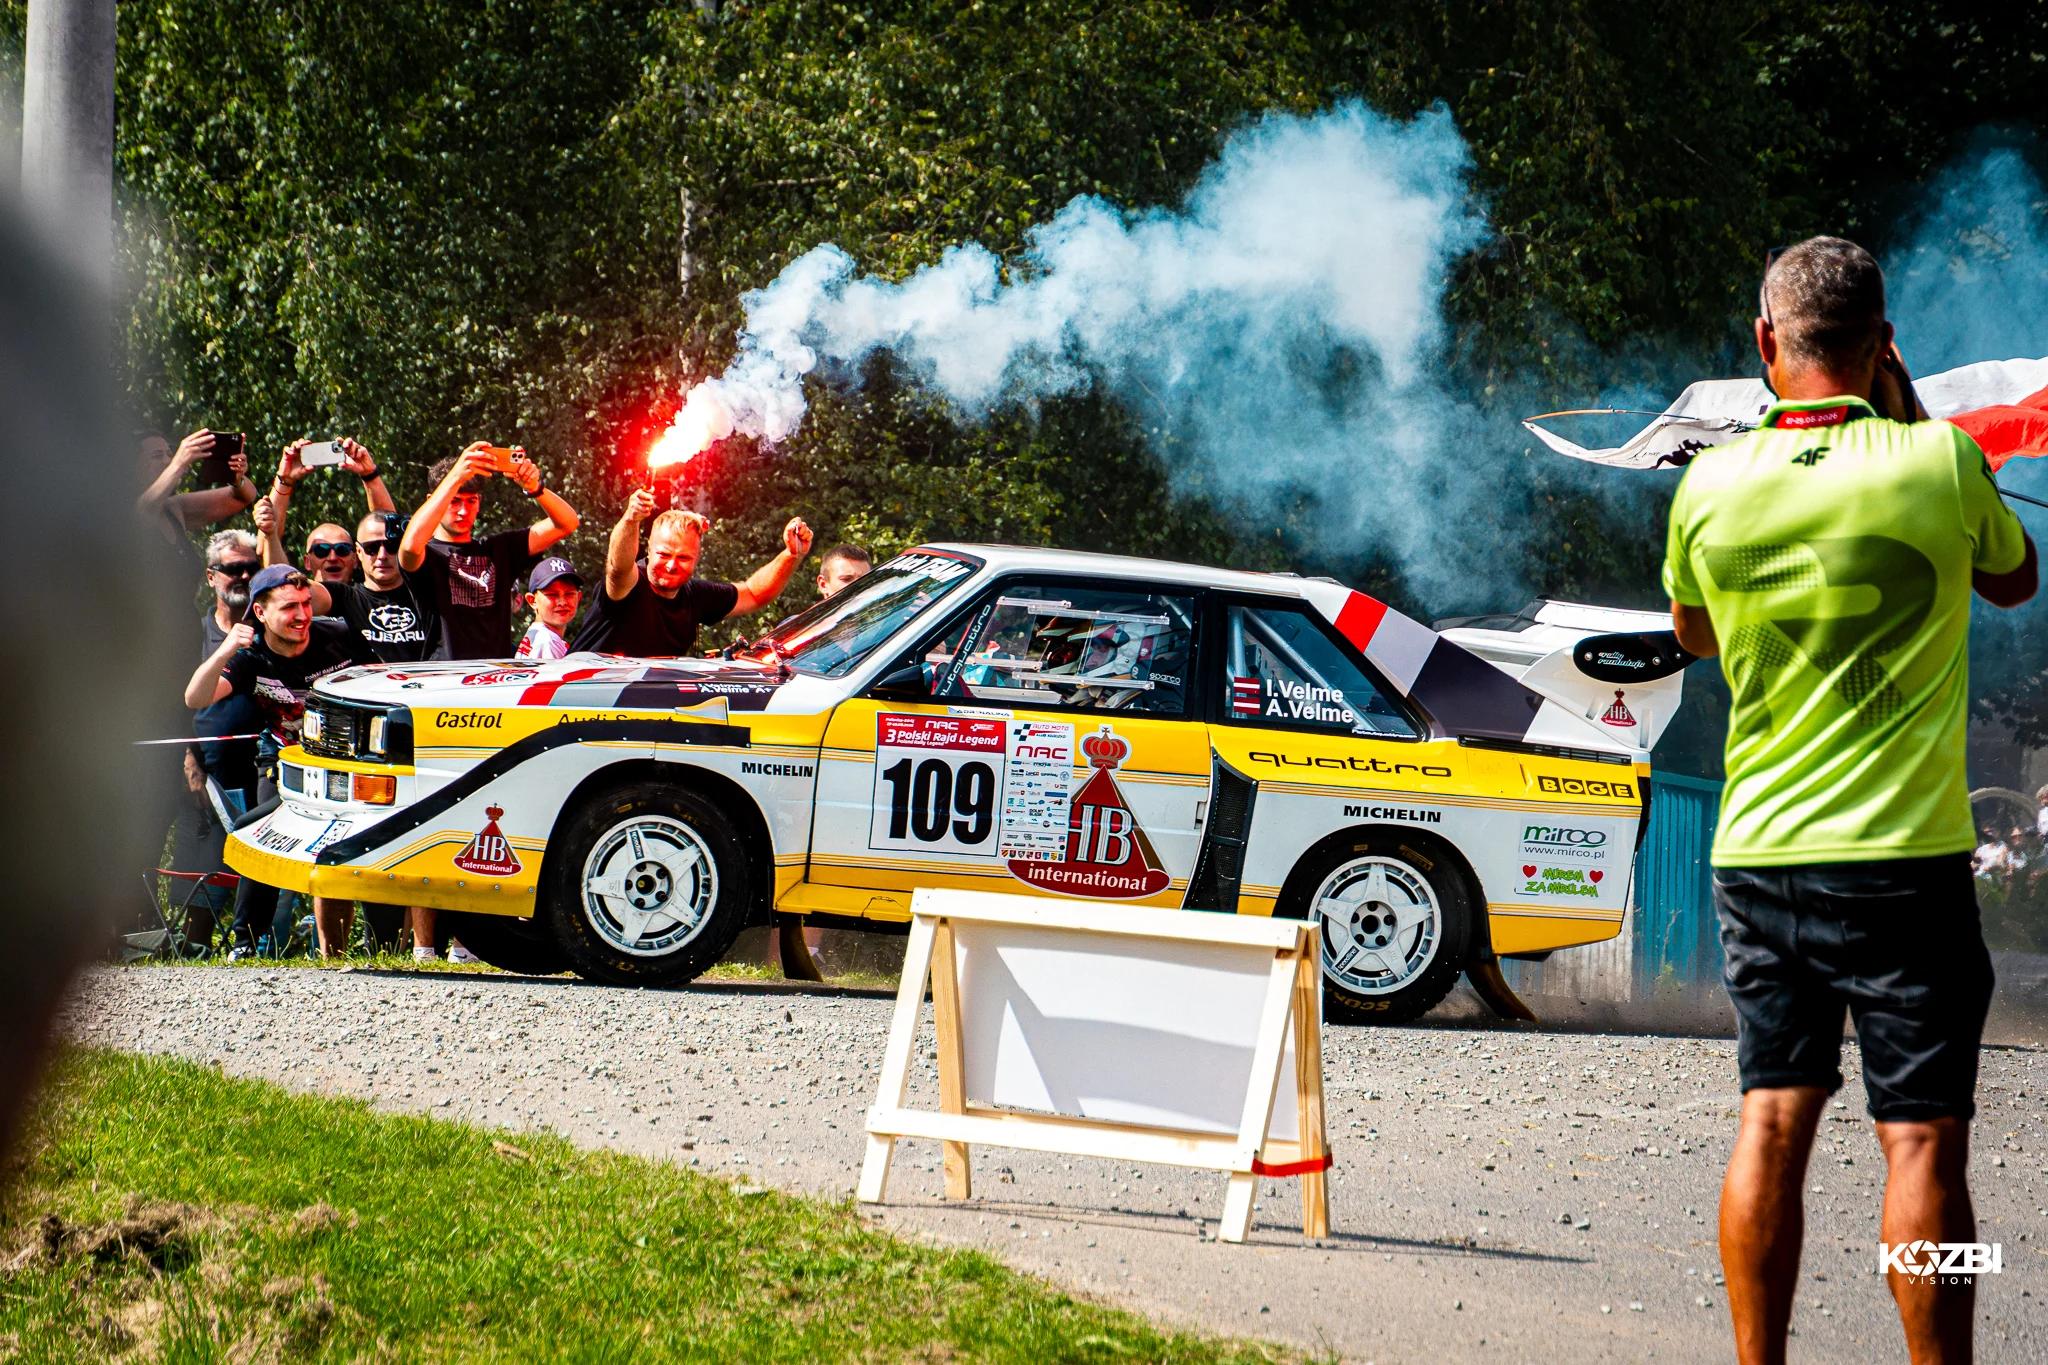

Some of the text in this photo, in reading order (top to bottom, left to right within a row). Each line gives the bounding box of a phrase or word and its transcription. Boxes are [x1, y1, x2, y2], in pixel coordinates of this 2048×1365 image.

[1792, 446, 1831, 466] 4F
[550, 560, 567, 572] NY
[361, 629, 425, 643] SUBARU
[1150, 672, 1180, 684] sparco
[1266, 678, 1344, 703] I.Velme
[436, 711, 502, 728] Castrol
[1266, 699, 1354, 723] A.Velme
[1610, 705, 1628, 720] HB
[885, 729, 999, 746] 3 Polski Rajd Legend
[742, 762, 814, 777] MICHELIN
[1248, 751, 1452, 778] quattro
[1541, 778, 1632, 797] BOGE
[883, 758, 995, 845] 109
[1344, 804, 1441, 823] MICHELIN
[1524, 826, 1606, 844] mirco
[472, 834, 506, 862] HB
[1524, 846, 1605, 860] www.mirco.pl
[462, 860, 512, 873] international
[1028, 863, 1148, 891] international
[1542, 868, 1585, 883] MUREM
[1525, 882, 1546, 893] ZA
